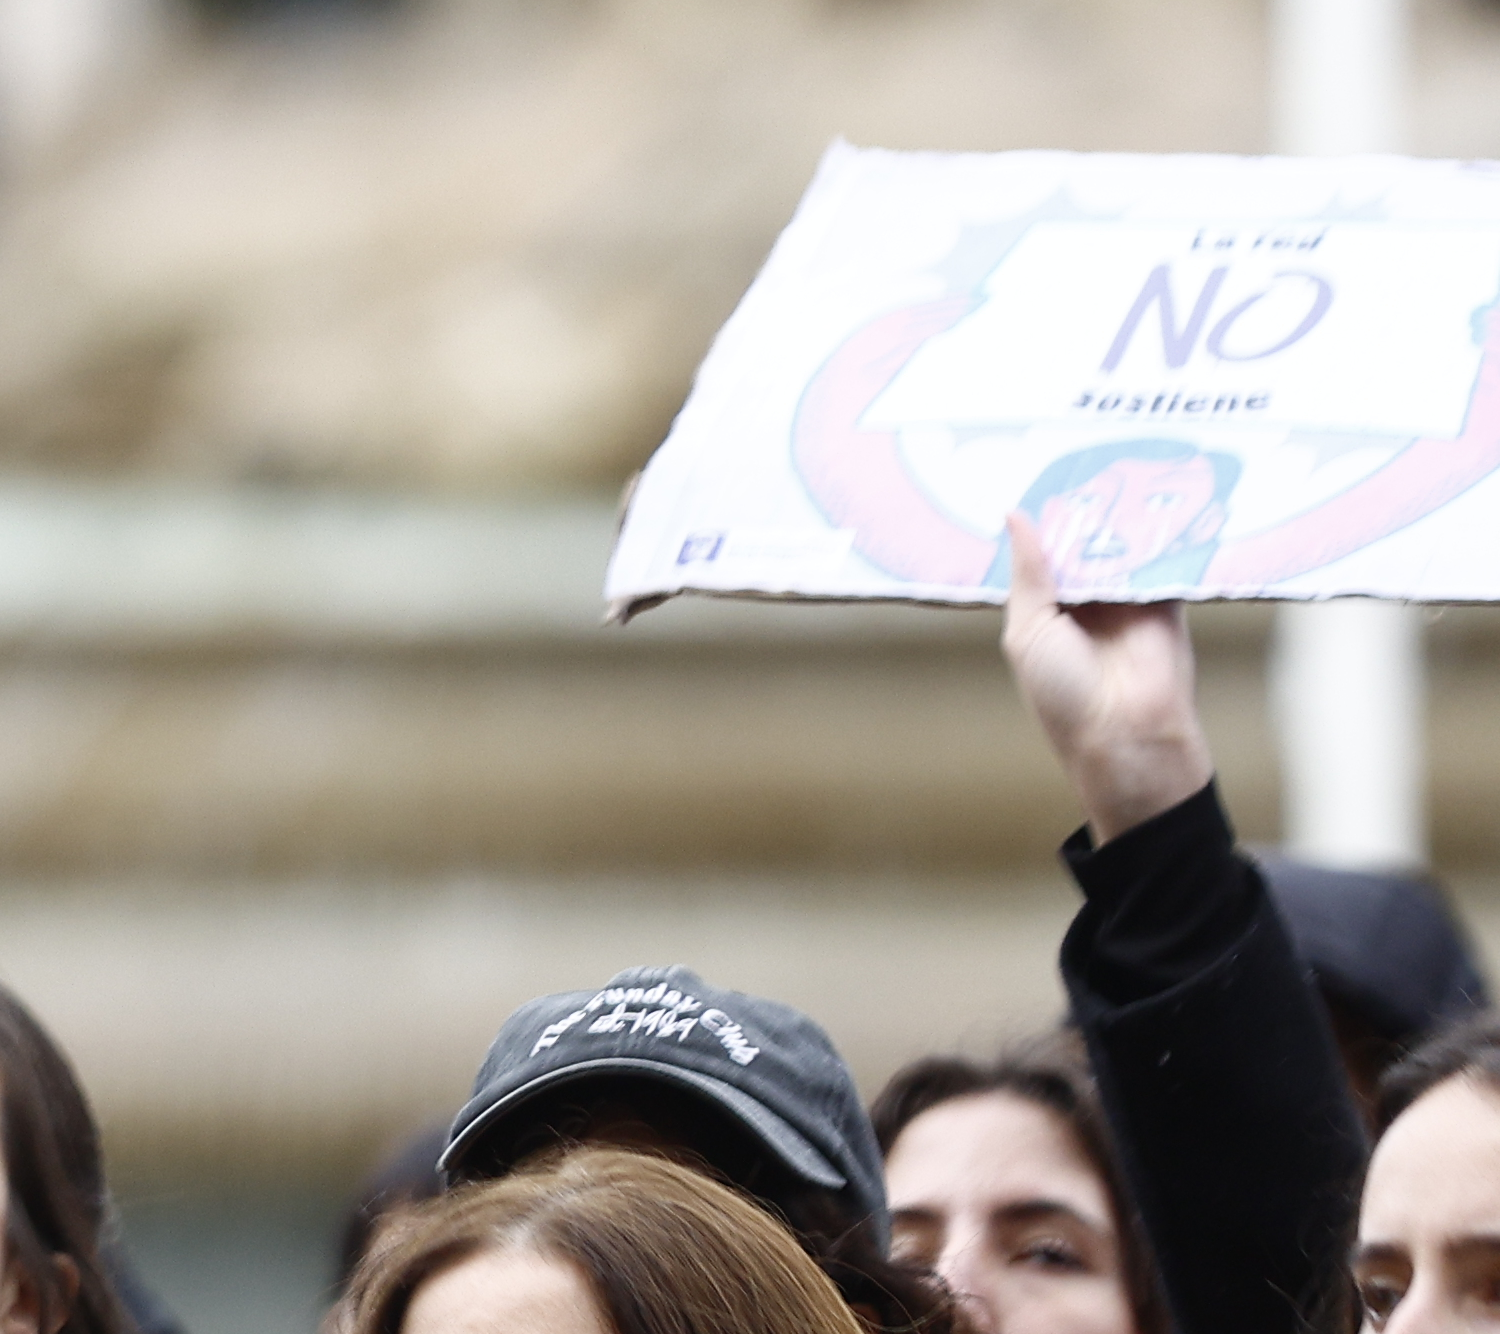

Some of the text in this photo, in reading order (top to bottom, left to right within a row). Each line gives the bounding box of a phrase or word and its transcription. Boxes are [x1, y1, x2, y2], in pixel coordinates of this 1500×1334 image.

[1252, 224, 1332, 252] red
[1098, 264, 1335, 375] NO
[1072, 386, 1274, 414] sostiene
